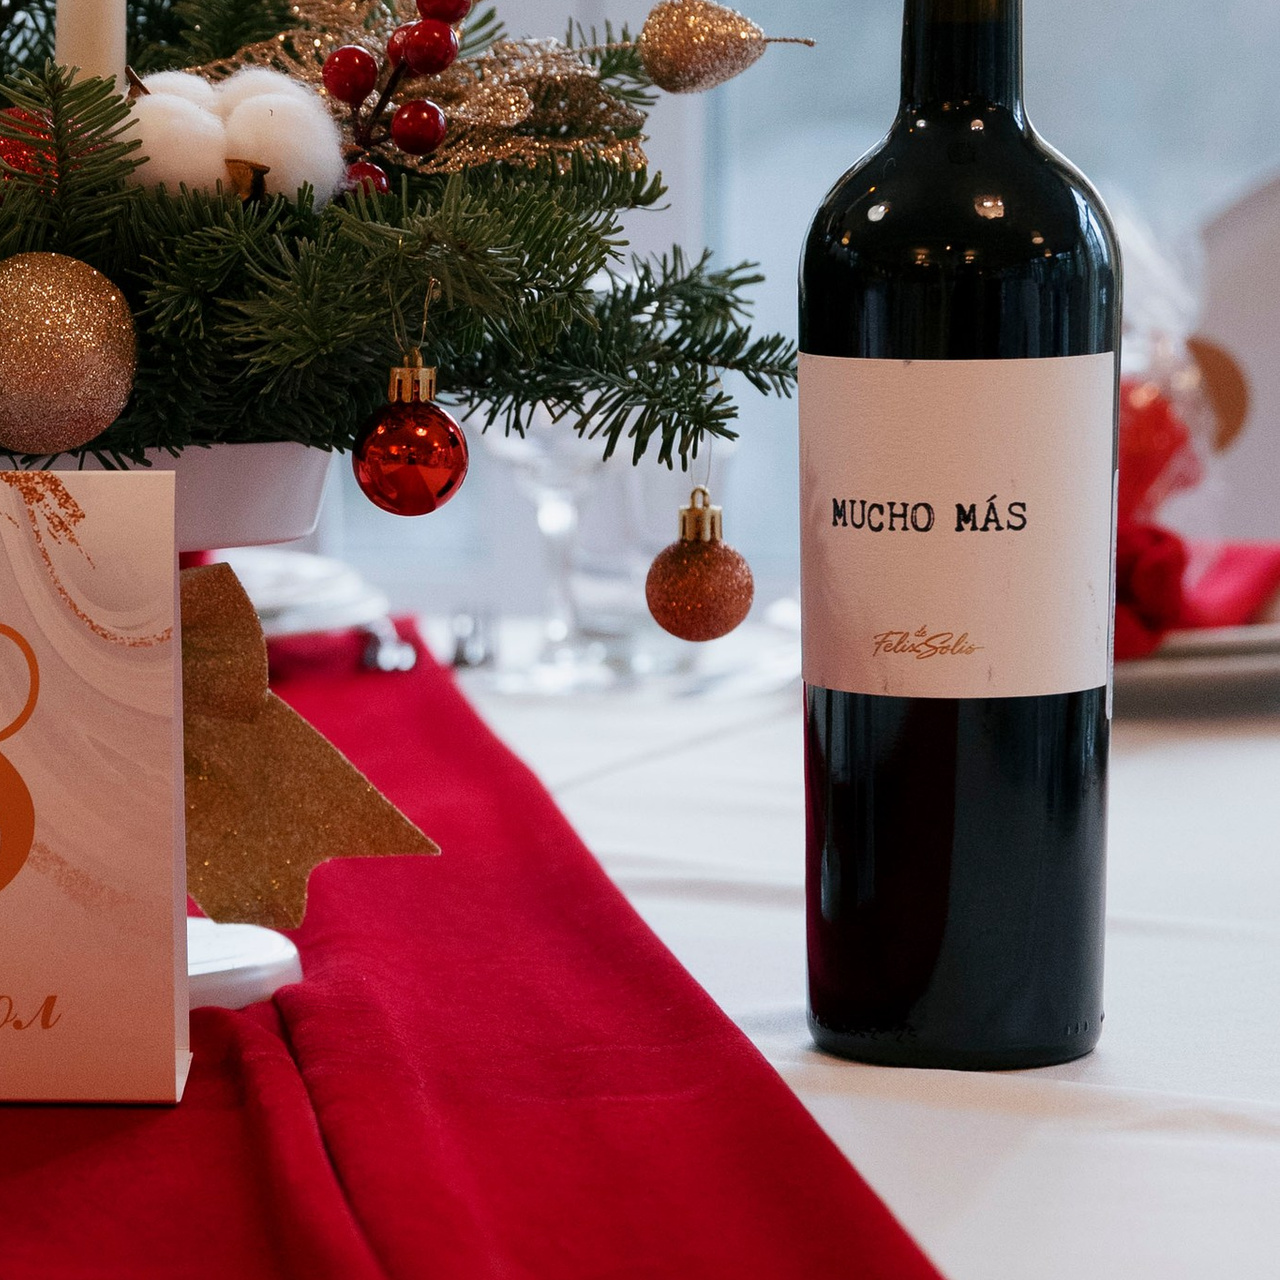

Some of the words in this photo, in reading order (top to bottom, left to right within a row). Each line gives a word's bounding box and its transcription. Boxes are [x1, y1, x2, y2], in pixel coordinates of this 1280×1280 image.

[832, 497, 935, 532] MUCHO
[954, 494, 1028, 532] MÁS
[873, 630, 920, 657] Felix
